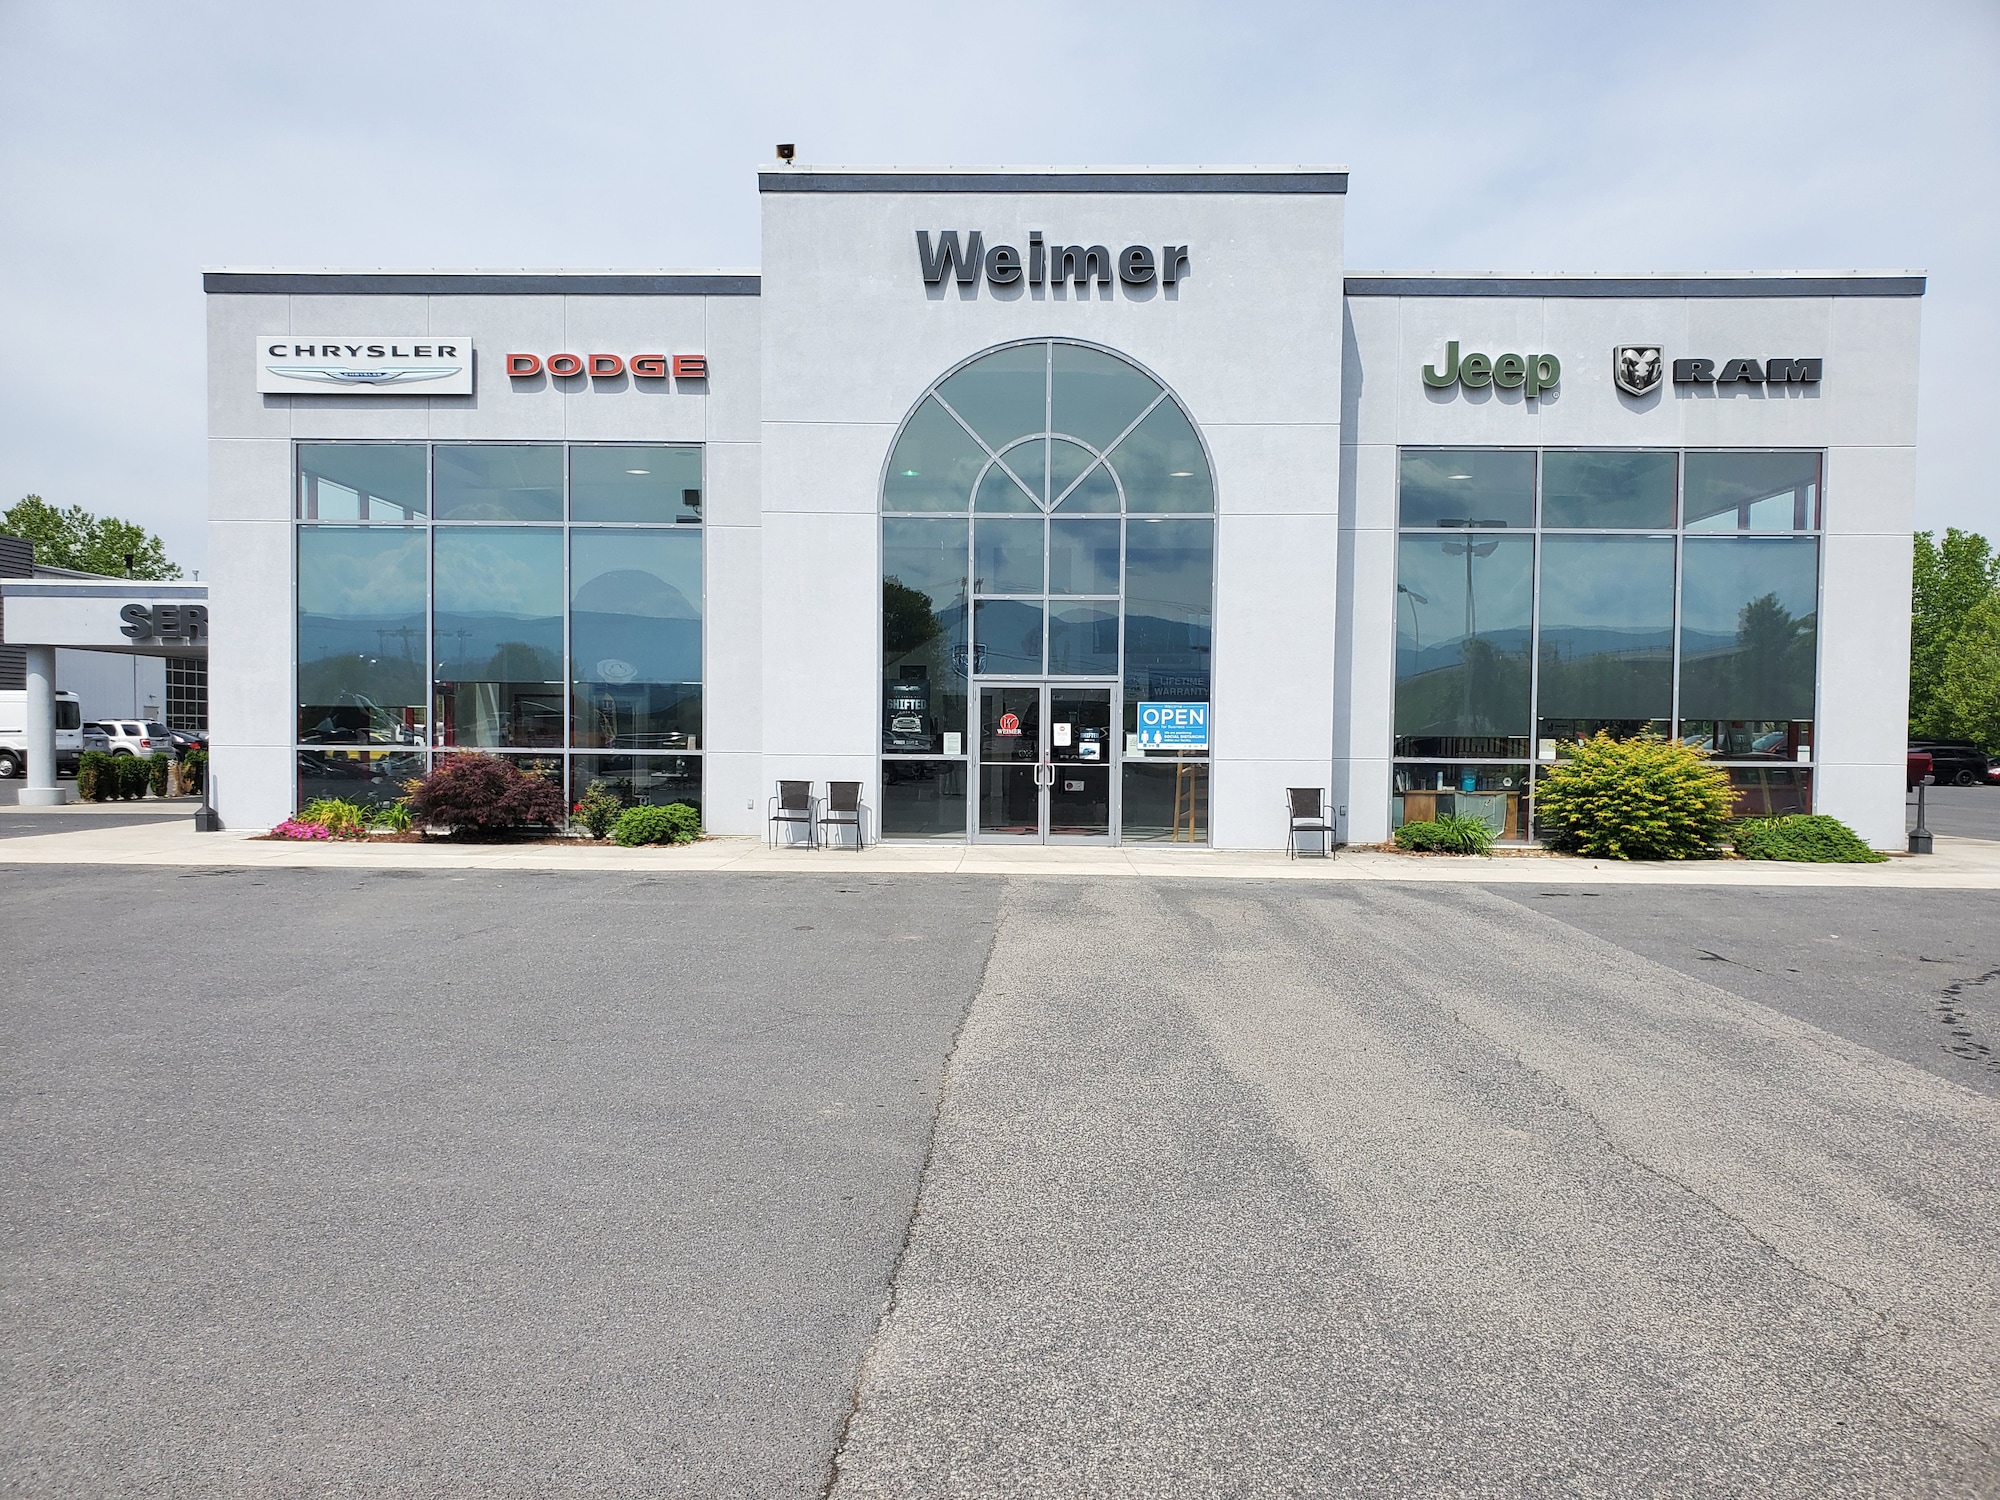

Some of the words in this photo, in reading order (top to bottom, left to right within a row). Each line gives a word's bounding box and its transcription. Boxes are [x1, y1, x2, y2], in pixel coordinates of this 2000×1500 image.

[915, 230, 1188, 284] Weimer
[268, 345, 457, 358] CHRYSLER
[506, 353, 706, 378] DODGE
[1422, 340, 1561, 398] Jeep
[1673, 358, 1823, 383] RAM
[120, 604, 208, 638] SER
[1154, 687, 1209, 696] WARRANTY
[1160, 677, 1204, 686] LIFETIME
[887, 698, 926, 710] SHIFTED
[1143, 708, 1204, 725] OPEN
